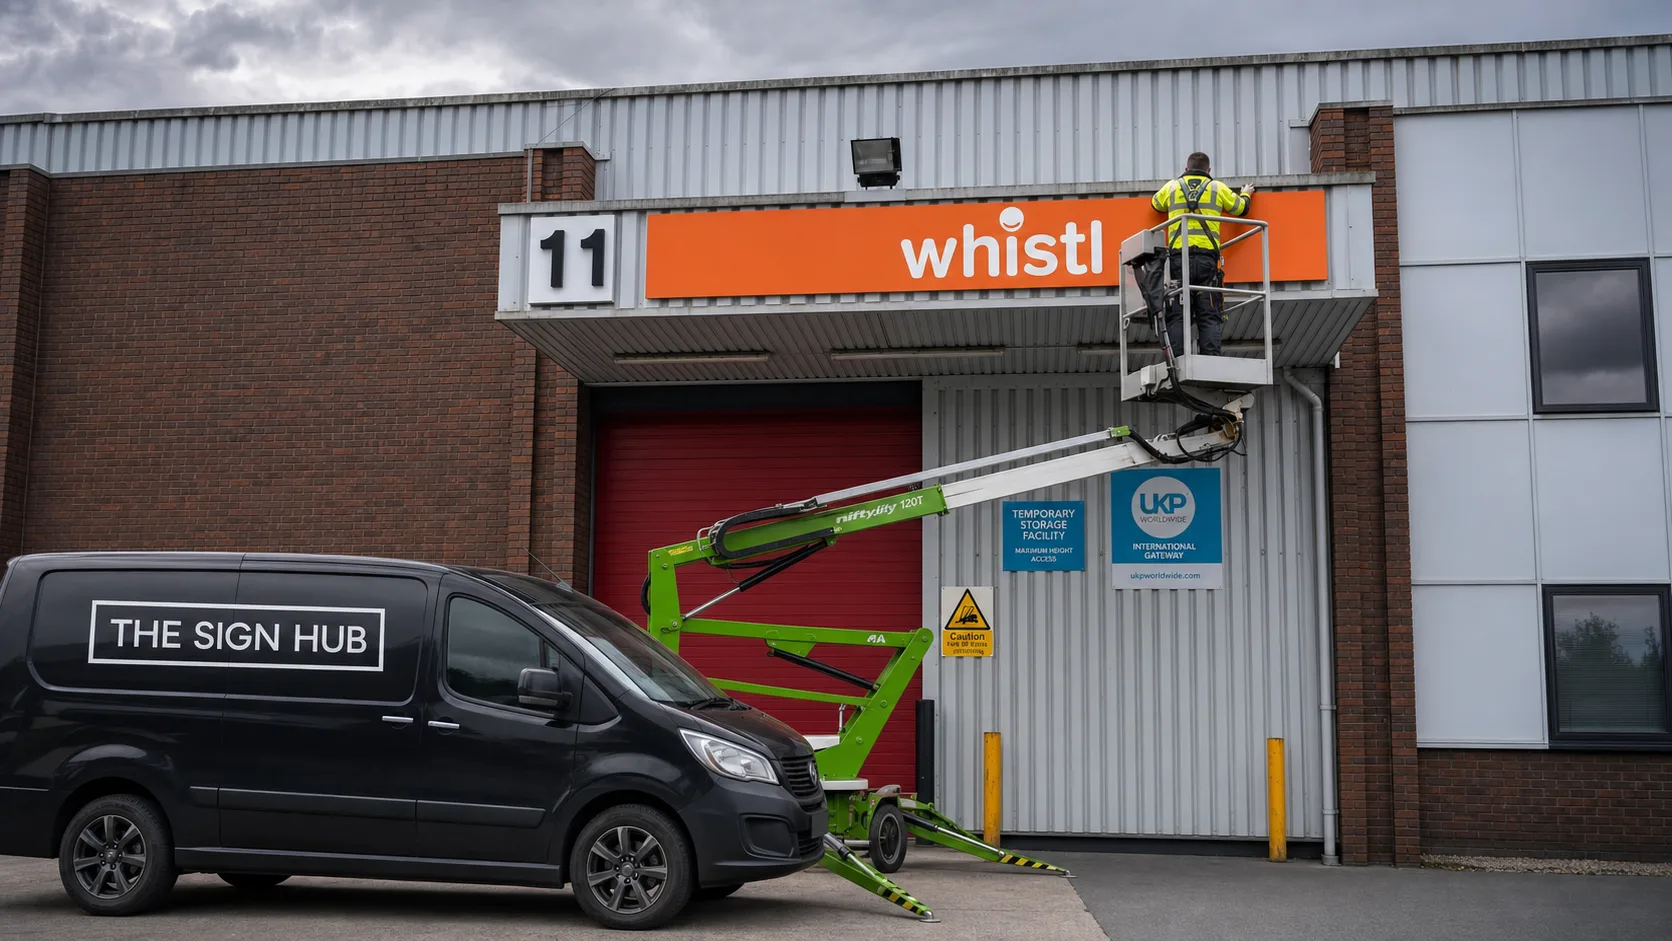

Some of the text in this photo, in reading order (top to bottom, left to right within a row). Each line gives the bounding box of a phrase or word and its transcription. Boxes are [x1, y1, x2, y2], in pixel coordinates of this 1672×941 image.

[900, 206, 1103, 279] whistl
[540, 228, 606, 289] 11
[900, 495, 923, 509] 120T
[1140, 493, 1187, 514] UKP
[1012, 509, 1075, 518] TEMPORARY
[1020, 520, 1067, 529] STORAGE
[1023, 531, 1065, 540] FACILITY
[110, 618, 368, 653] THE SIGN HUB
[950, 632, 985, 640] Caution
